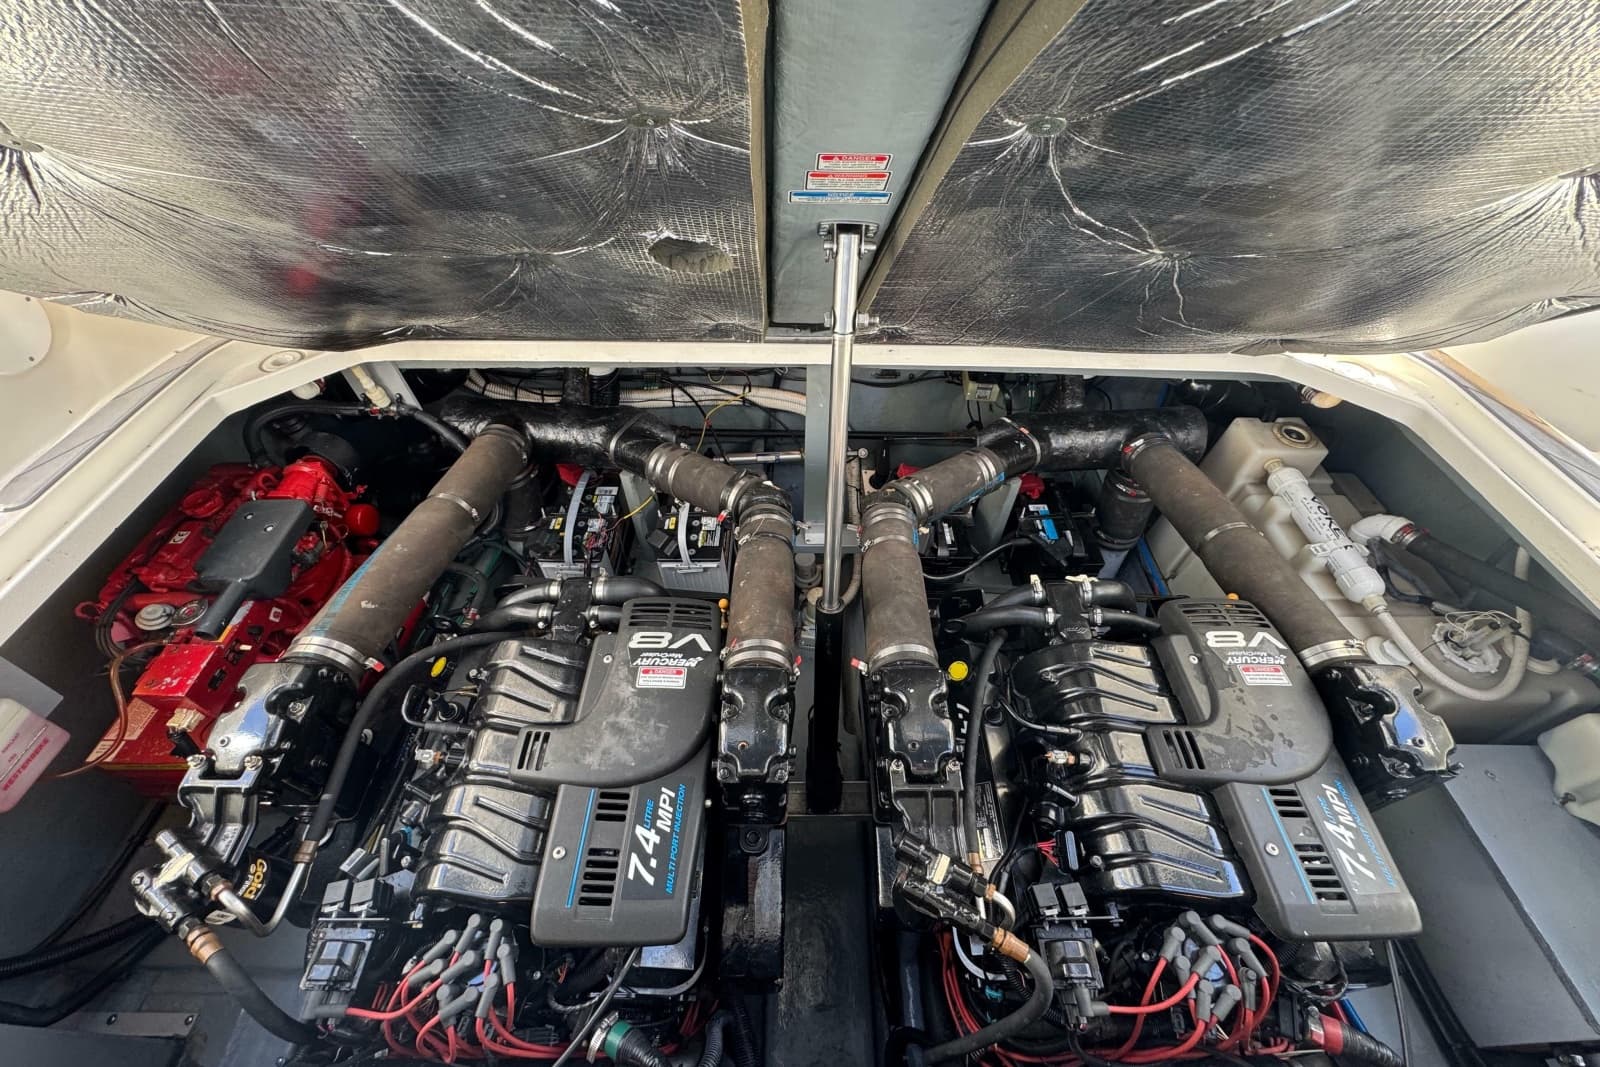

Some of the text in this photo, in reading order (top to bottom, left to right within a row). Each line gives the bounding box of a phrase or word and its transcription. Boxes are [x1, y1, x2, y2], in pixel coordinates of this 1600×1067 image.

[628, 631, 713, 652] V8
[1205, 630, 1289, 650] V8
[1226, 655, 1287, 665] MERCURY
[633, 656, 704, 668] MERCURY
[643, 799, 654, 829] LITRE
[656, 787, 676, 832] MPI
[1321, 783, 1357, 828] MPI
[628, 824, 660, 886] 7.4
[665, 783, 687, 894] MULTI PORT INJECTION
[1323, 821, 1376, 880] 7.4
[243, 859, 267, 899] Gold
